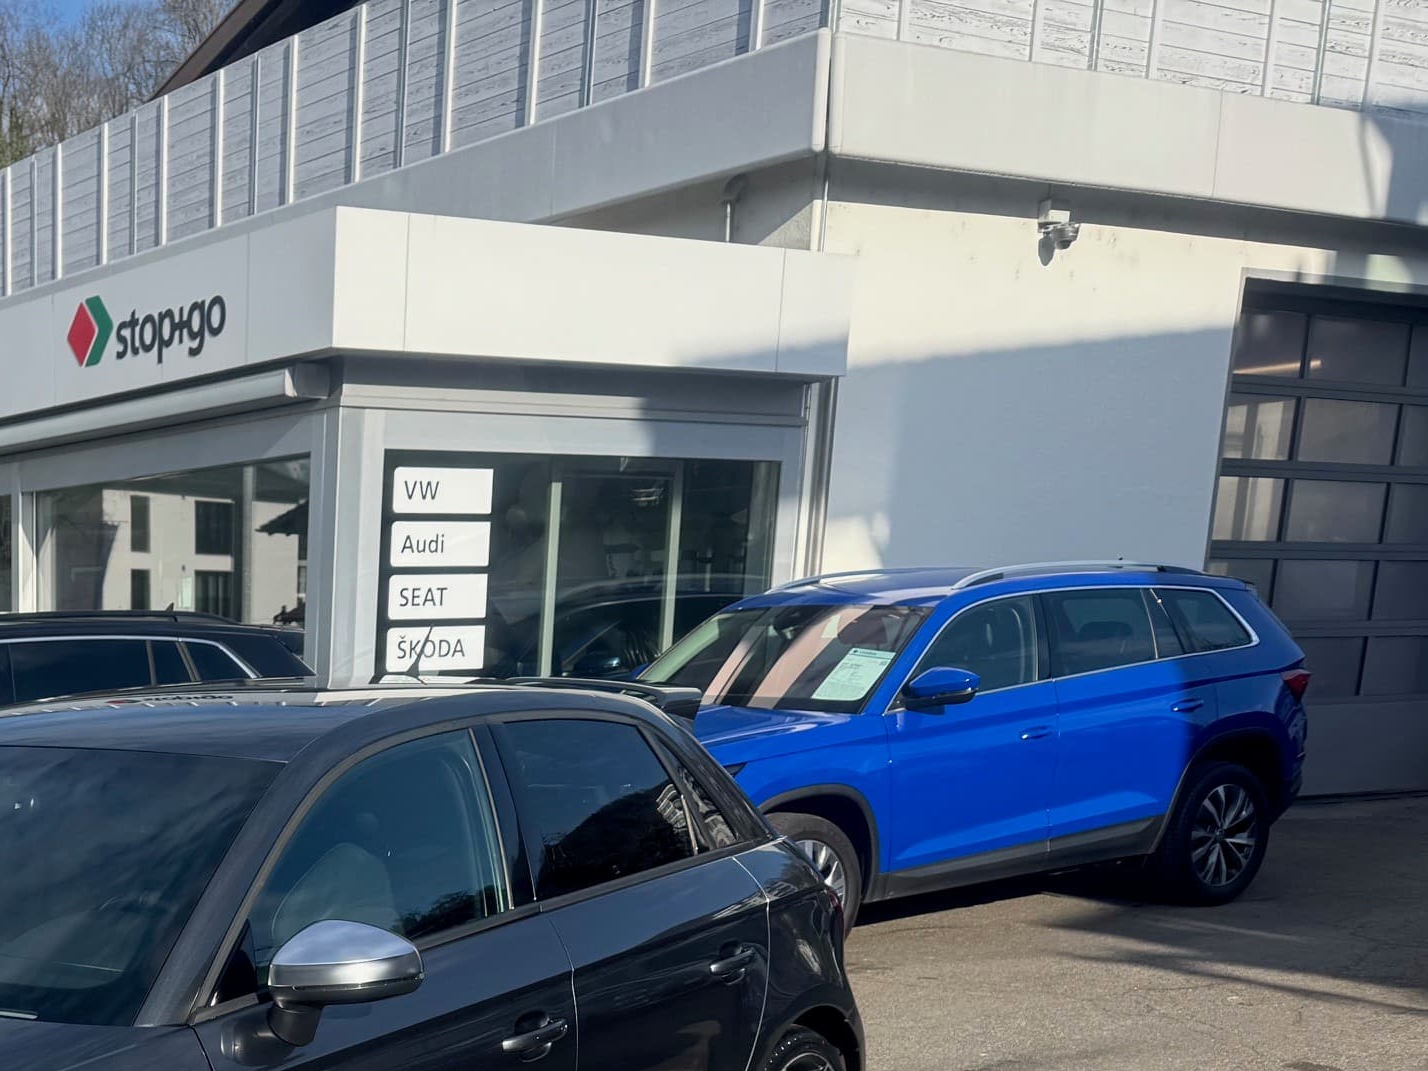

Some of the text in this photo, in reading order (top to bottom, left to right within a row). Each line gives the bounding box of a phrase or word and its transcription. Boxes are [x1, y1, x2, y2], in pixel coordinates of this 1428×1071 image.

[115, 294, 227, 364] stop+go
[403, 480, 440, 501] VW
[400, 533, 445, 554] Audi
[398, 587, 449, 607] SEAT
[396, 634, 466, 660] ŠKODA
